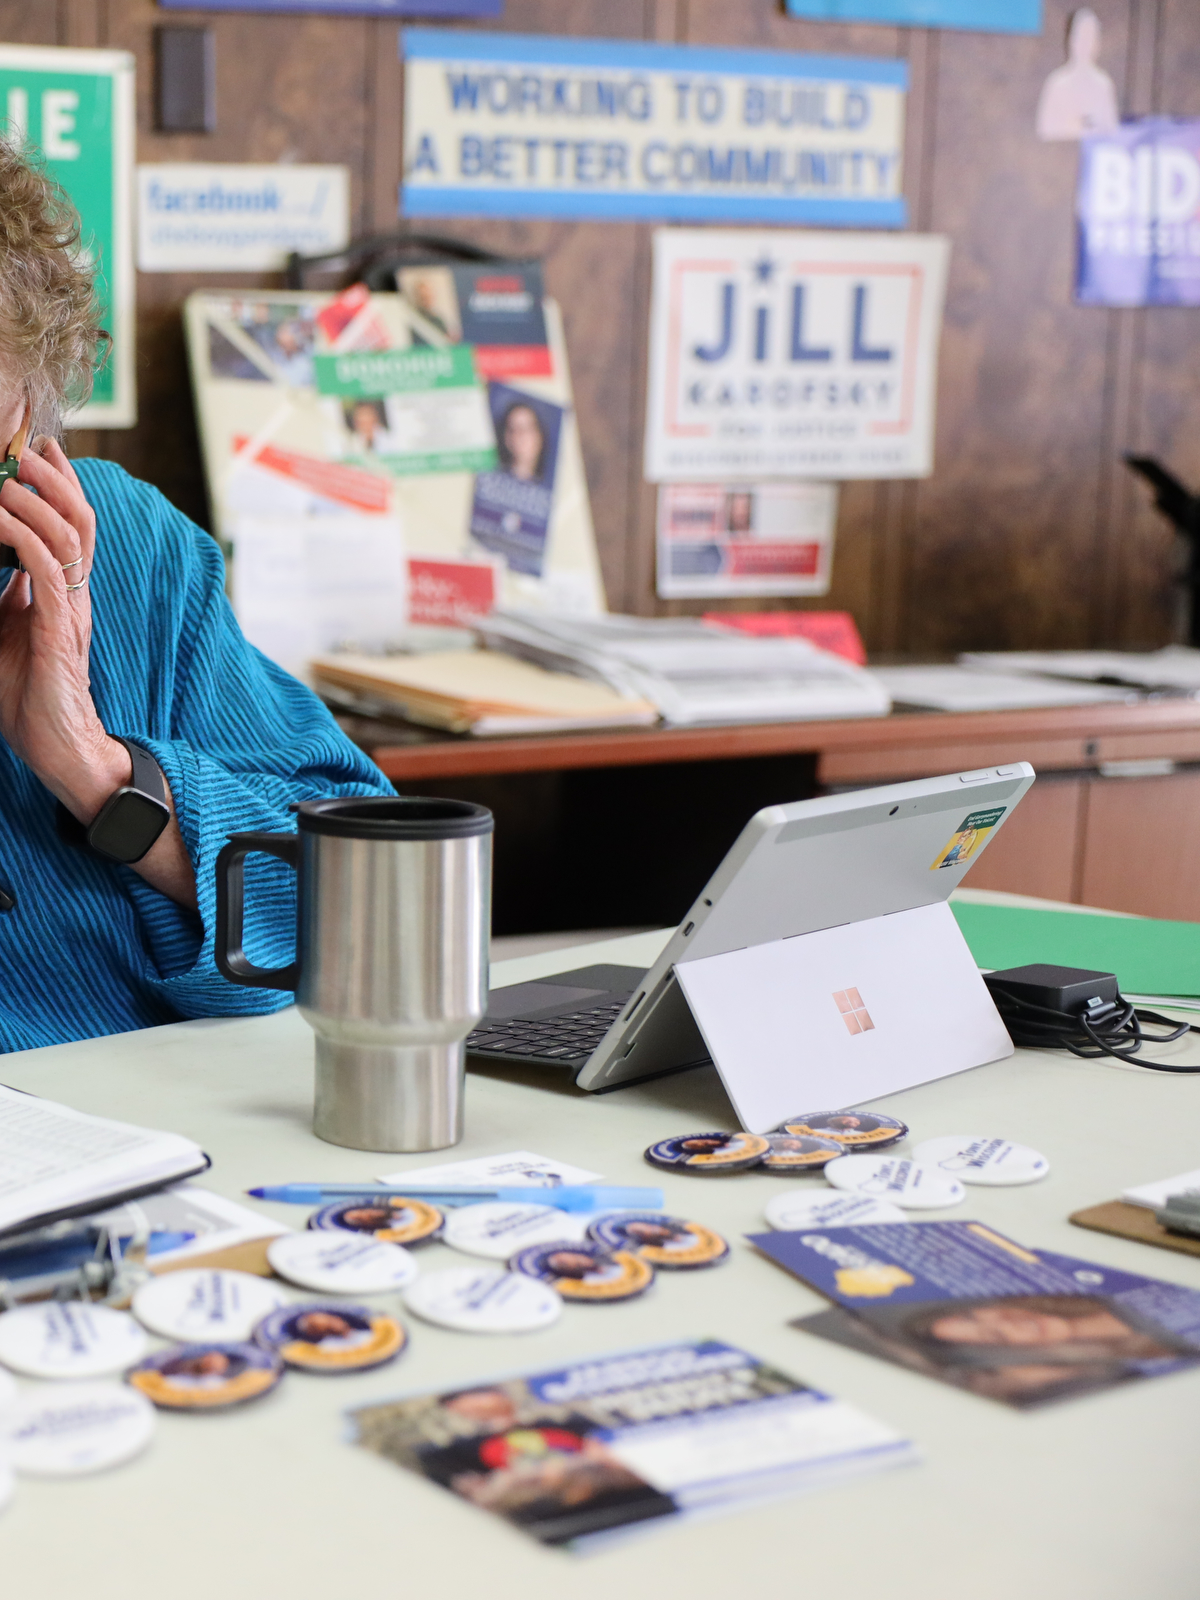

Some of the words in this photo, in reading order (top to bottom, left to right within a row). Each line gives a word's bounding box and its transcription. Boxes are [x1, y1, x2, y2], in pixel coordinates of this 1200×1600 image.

[445, 70, 653, 122] WORKING
[673, 80, 726, 122] TO
[743, 84, 872, 130] BUILD
[412, 134, 440, 176] A
[460, 135, 628, 183] BETTER
[640, 142, 898, 191] COMMUNITY
[1092, 147, 1200, 219] BID
